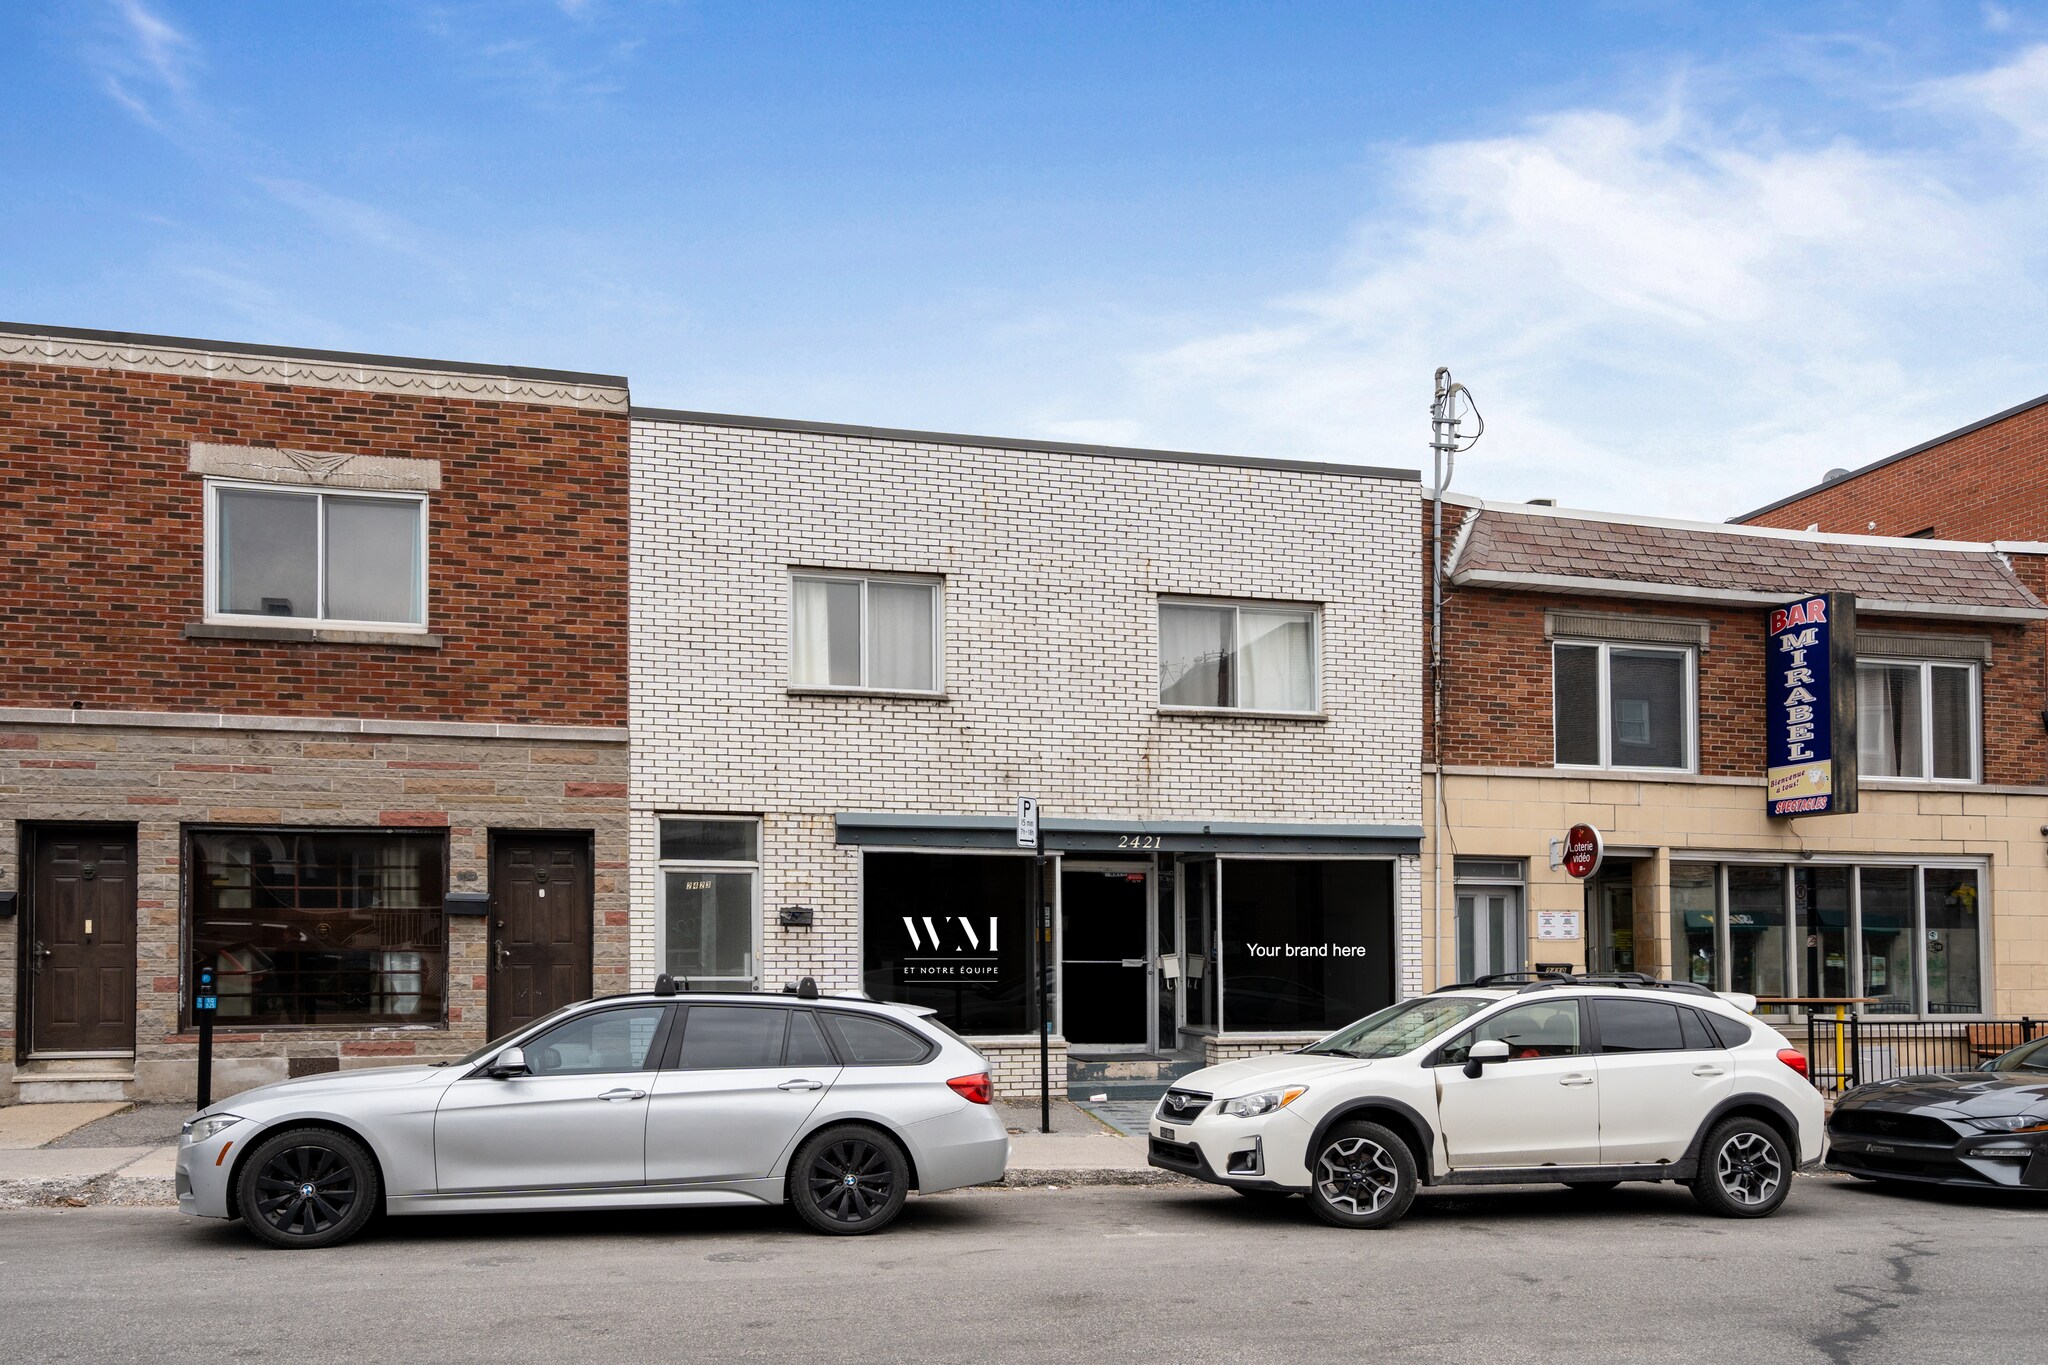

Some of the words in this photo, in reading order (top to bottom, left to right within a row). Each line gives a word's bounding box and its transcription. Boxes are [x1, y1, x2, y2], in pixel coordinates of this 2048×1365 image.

[1770, 598, 1827, 637] BAR
[1779, 627, 1819, 761] MIRABEL
[1770, 770, 1805, 788] Bienvenue
[1782, 779, 1799, 791] tous!
[1023, 800, 1031, 818] P
[1775, 796, 1827, 814] SPECTACLES
[1117, 835, 1162, 849] 2421
[1569, 840, 1594, 853] Loterie
[1572, 852, 1591, 863] vidéo
